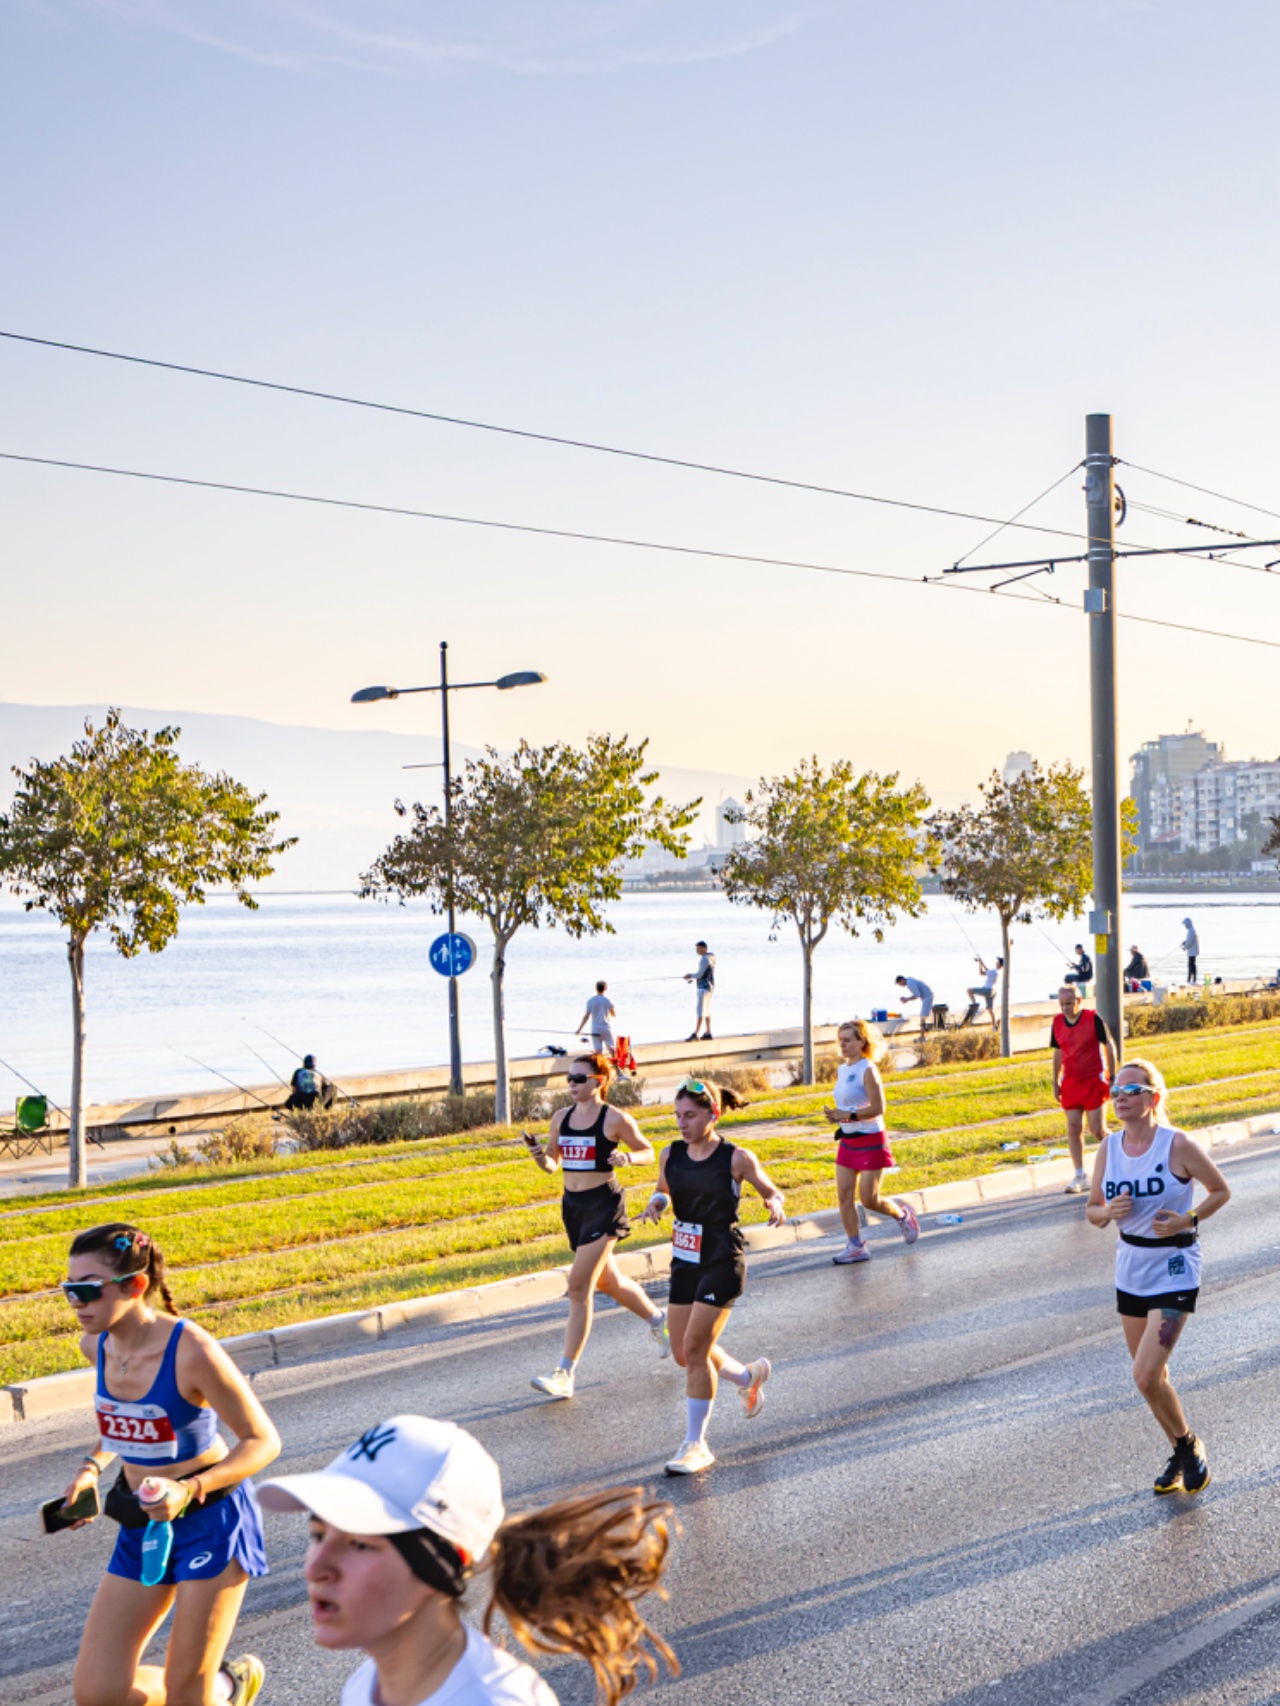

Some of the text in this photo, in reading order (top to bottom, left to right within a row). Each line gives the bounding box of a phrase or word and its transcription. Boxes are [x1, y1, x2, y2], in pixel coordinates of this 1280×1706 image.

[562, 1146, 588, 1158] 1137
[1106, 1177, 1165, 1200] BOLD
[104, 1415, 159, 1440] 2324
